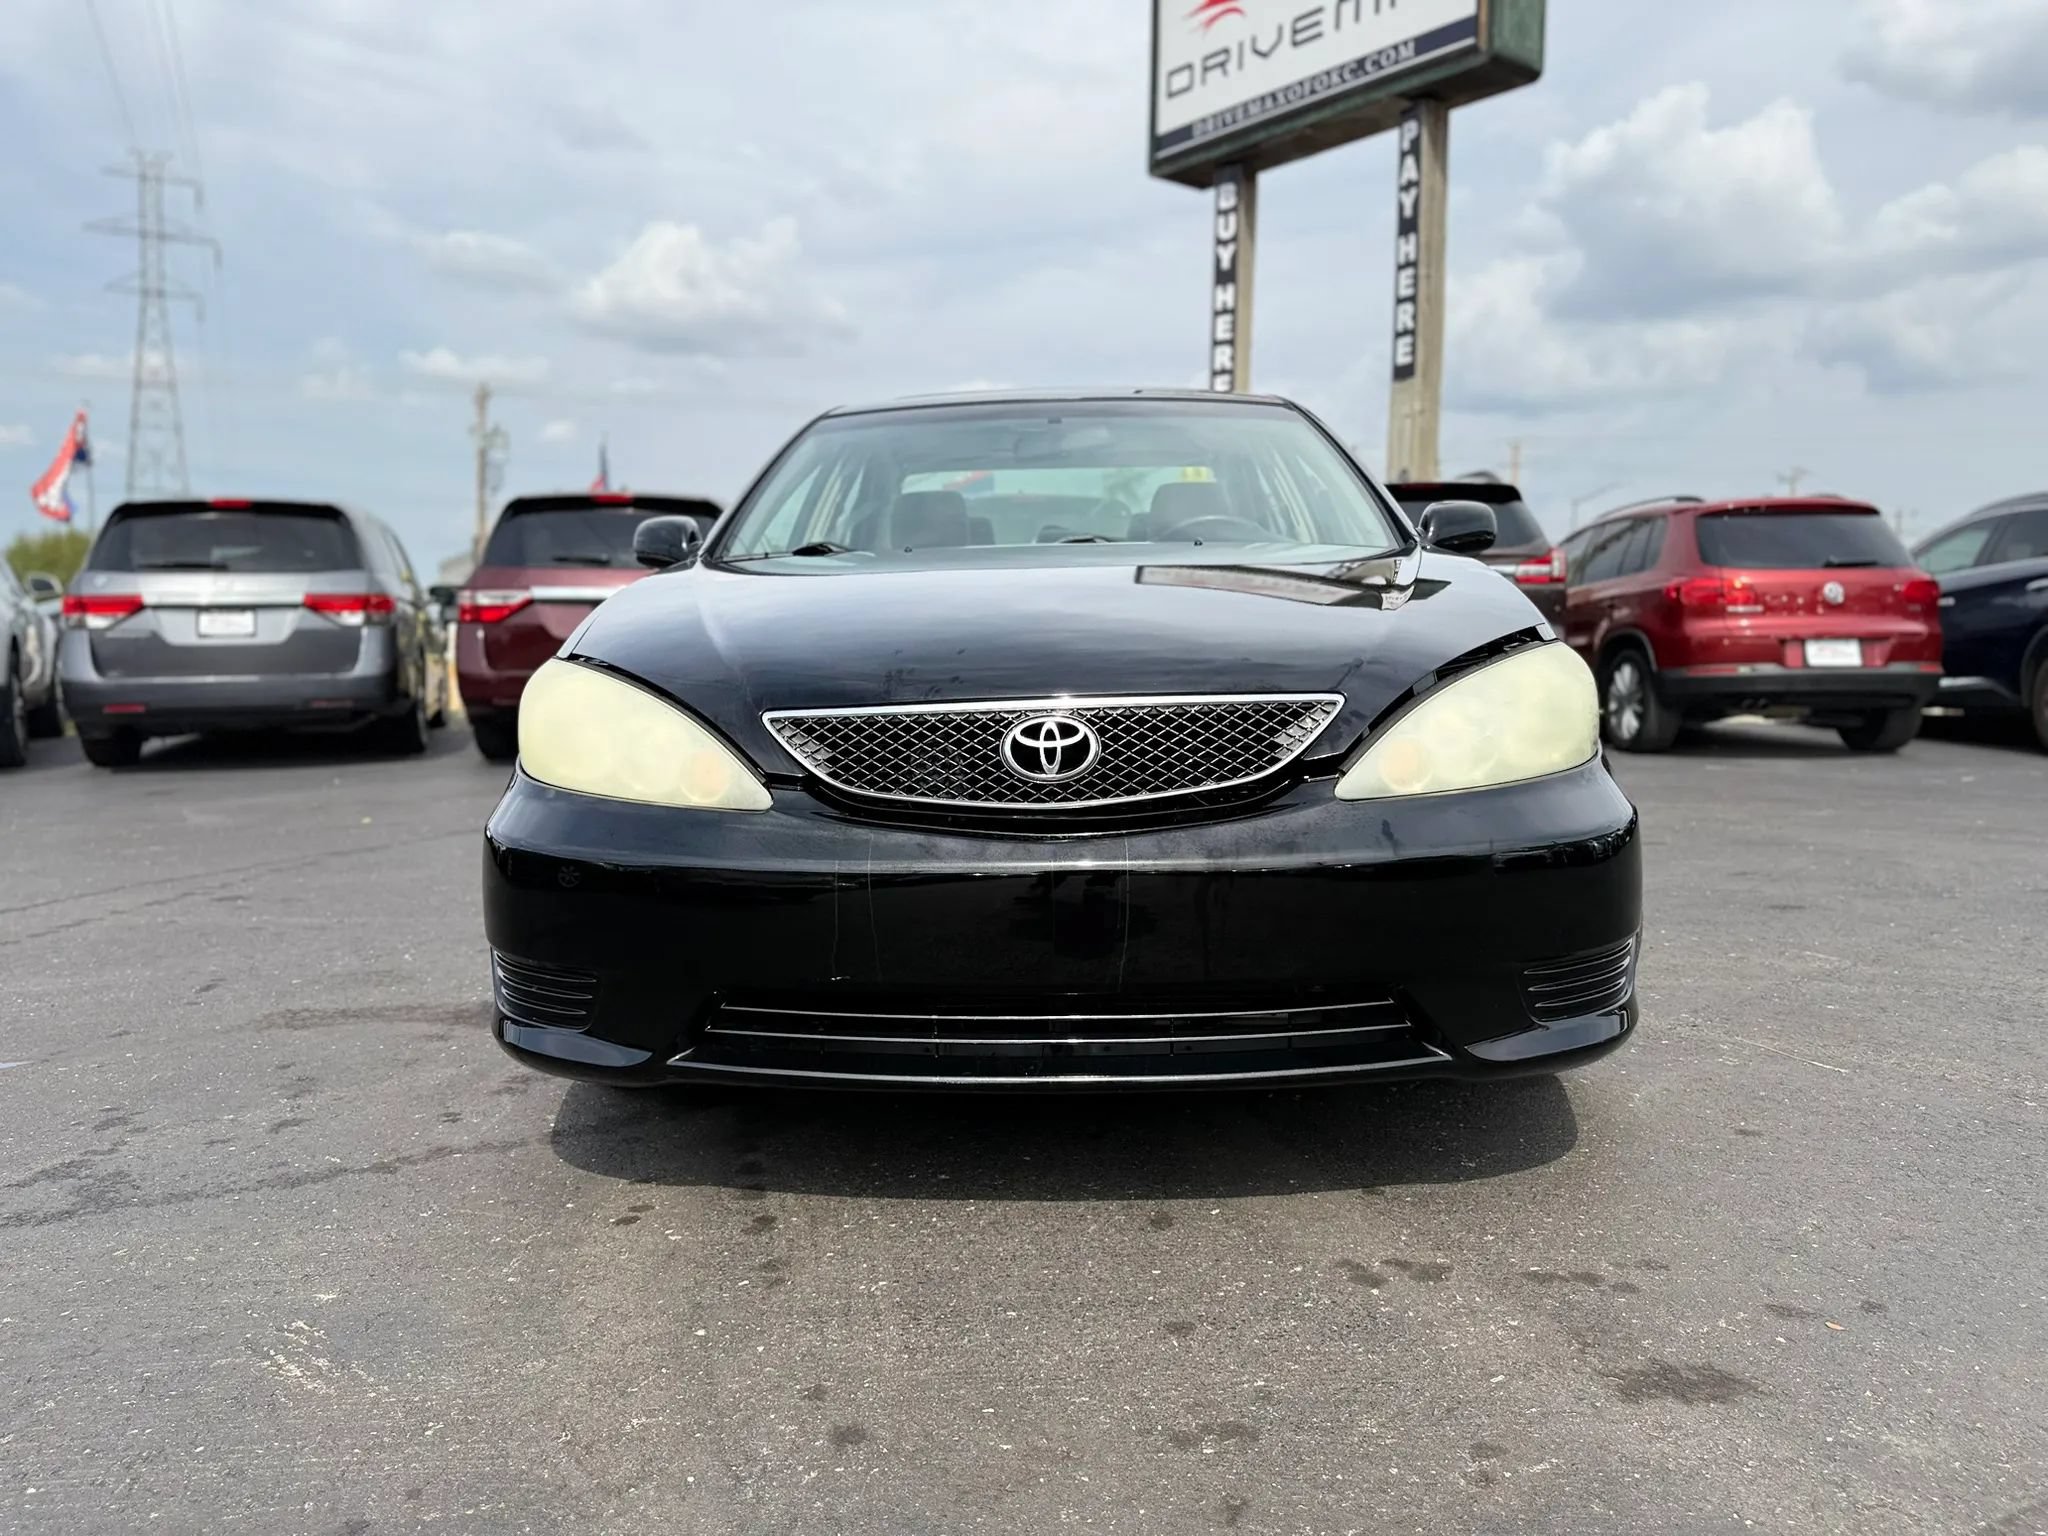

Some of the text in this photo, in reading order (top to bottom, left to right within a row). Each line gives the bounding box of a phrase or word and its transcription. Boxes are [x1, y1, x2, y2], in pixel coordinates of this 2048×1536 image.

[1166, 0, 1396, 99] DRIVEM
[1216, 182, 1238, 271] BUY
[1395, 119, 1419, 367] PAY HERE
